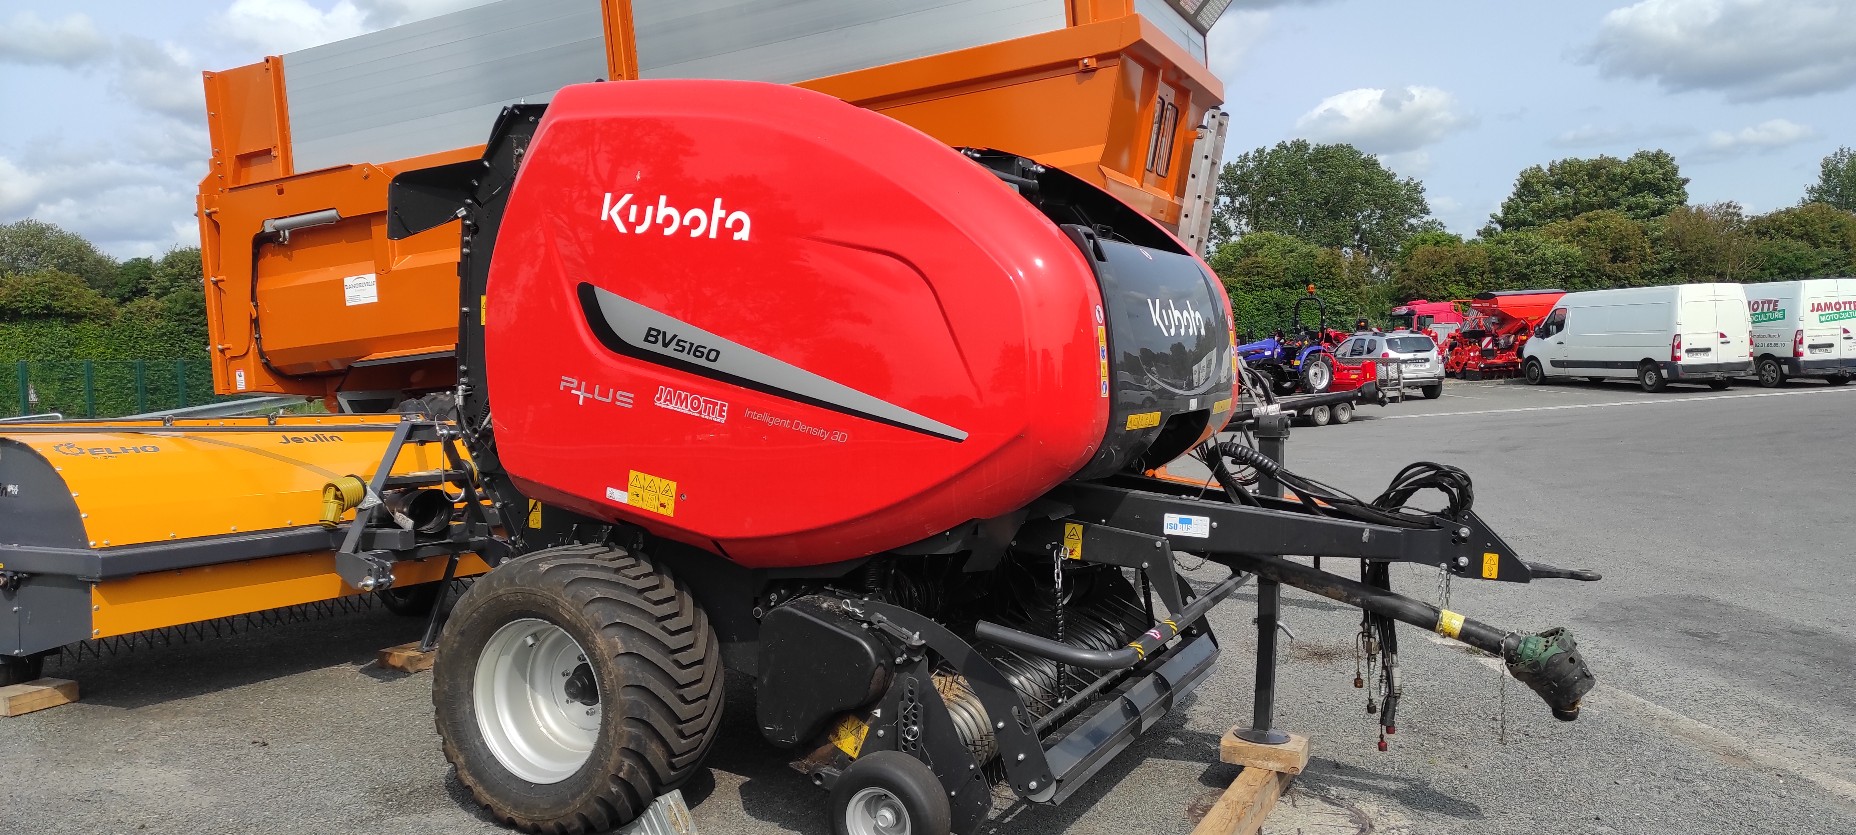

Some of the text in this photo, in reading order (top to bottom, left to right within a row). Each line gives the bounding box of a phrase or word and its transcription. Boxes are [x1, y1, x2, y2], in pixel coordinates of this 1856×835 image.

[601, 192, 751, 241] Kubota
[1147, 299, 1205, 336] Kubota
[643, 326, 721, 363] BV5160
[559, 375, 634, 409] PLUS
[653, 385, 729, 421] JAMOTTE
[279, 433, 344, 444] Jeulin
[744, 408, 790, 429] Intelligent
[792, 419, 830, 440] Density
[831, 430, 848, 443] 3D
[87, 445, 160, 456] ELHO
